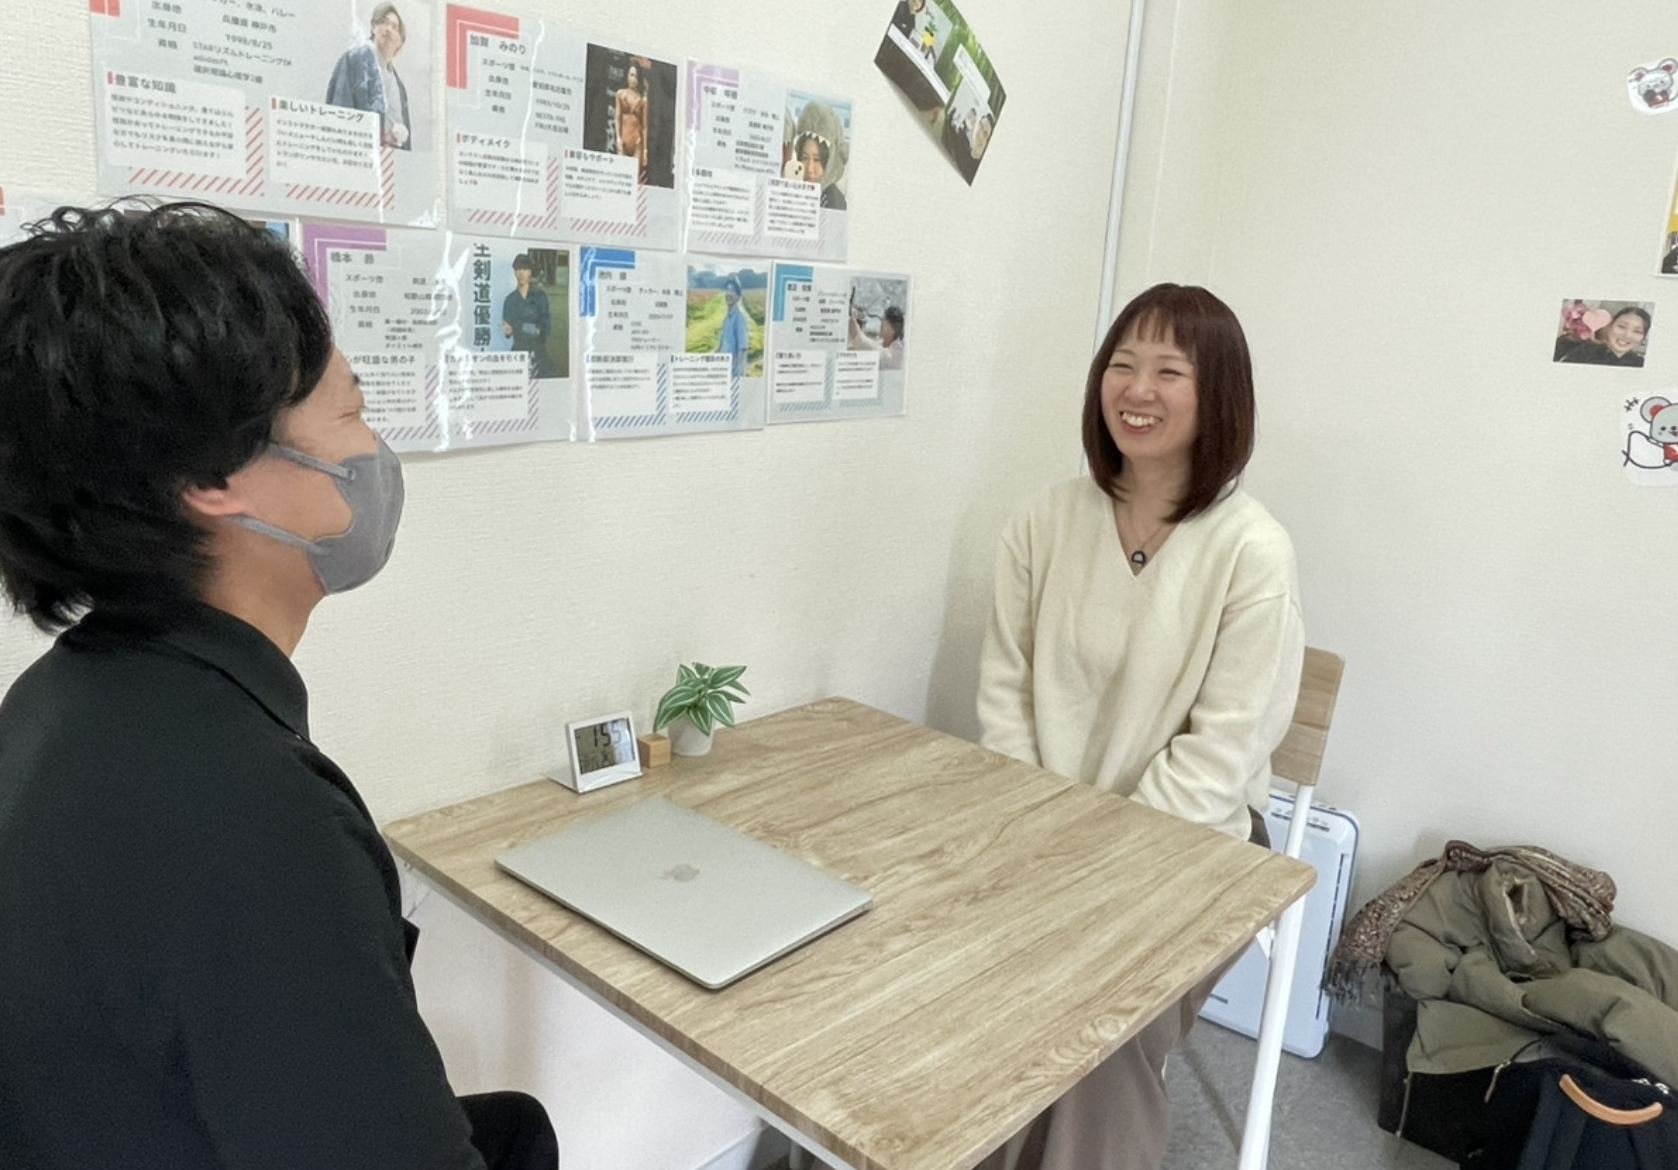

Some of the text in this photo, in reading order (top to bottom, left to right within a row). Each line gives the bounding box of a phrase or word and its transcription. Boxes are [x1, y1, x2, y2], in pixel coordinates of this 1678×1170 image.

[147, 17, 187, 33] 生年月日
[499, 41, 526, 54] みのり
[115, 74, 177, 93] 豊富な知識
[279, 100, 364, 123] 楽しいトレーニング
[462, 134, 510, 148] ボディメイク
[350, 354, 416, 365] が旺盛な男の子
